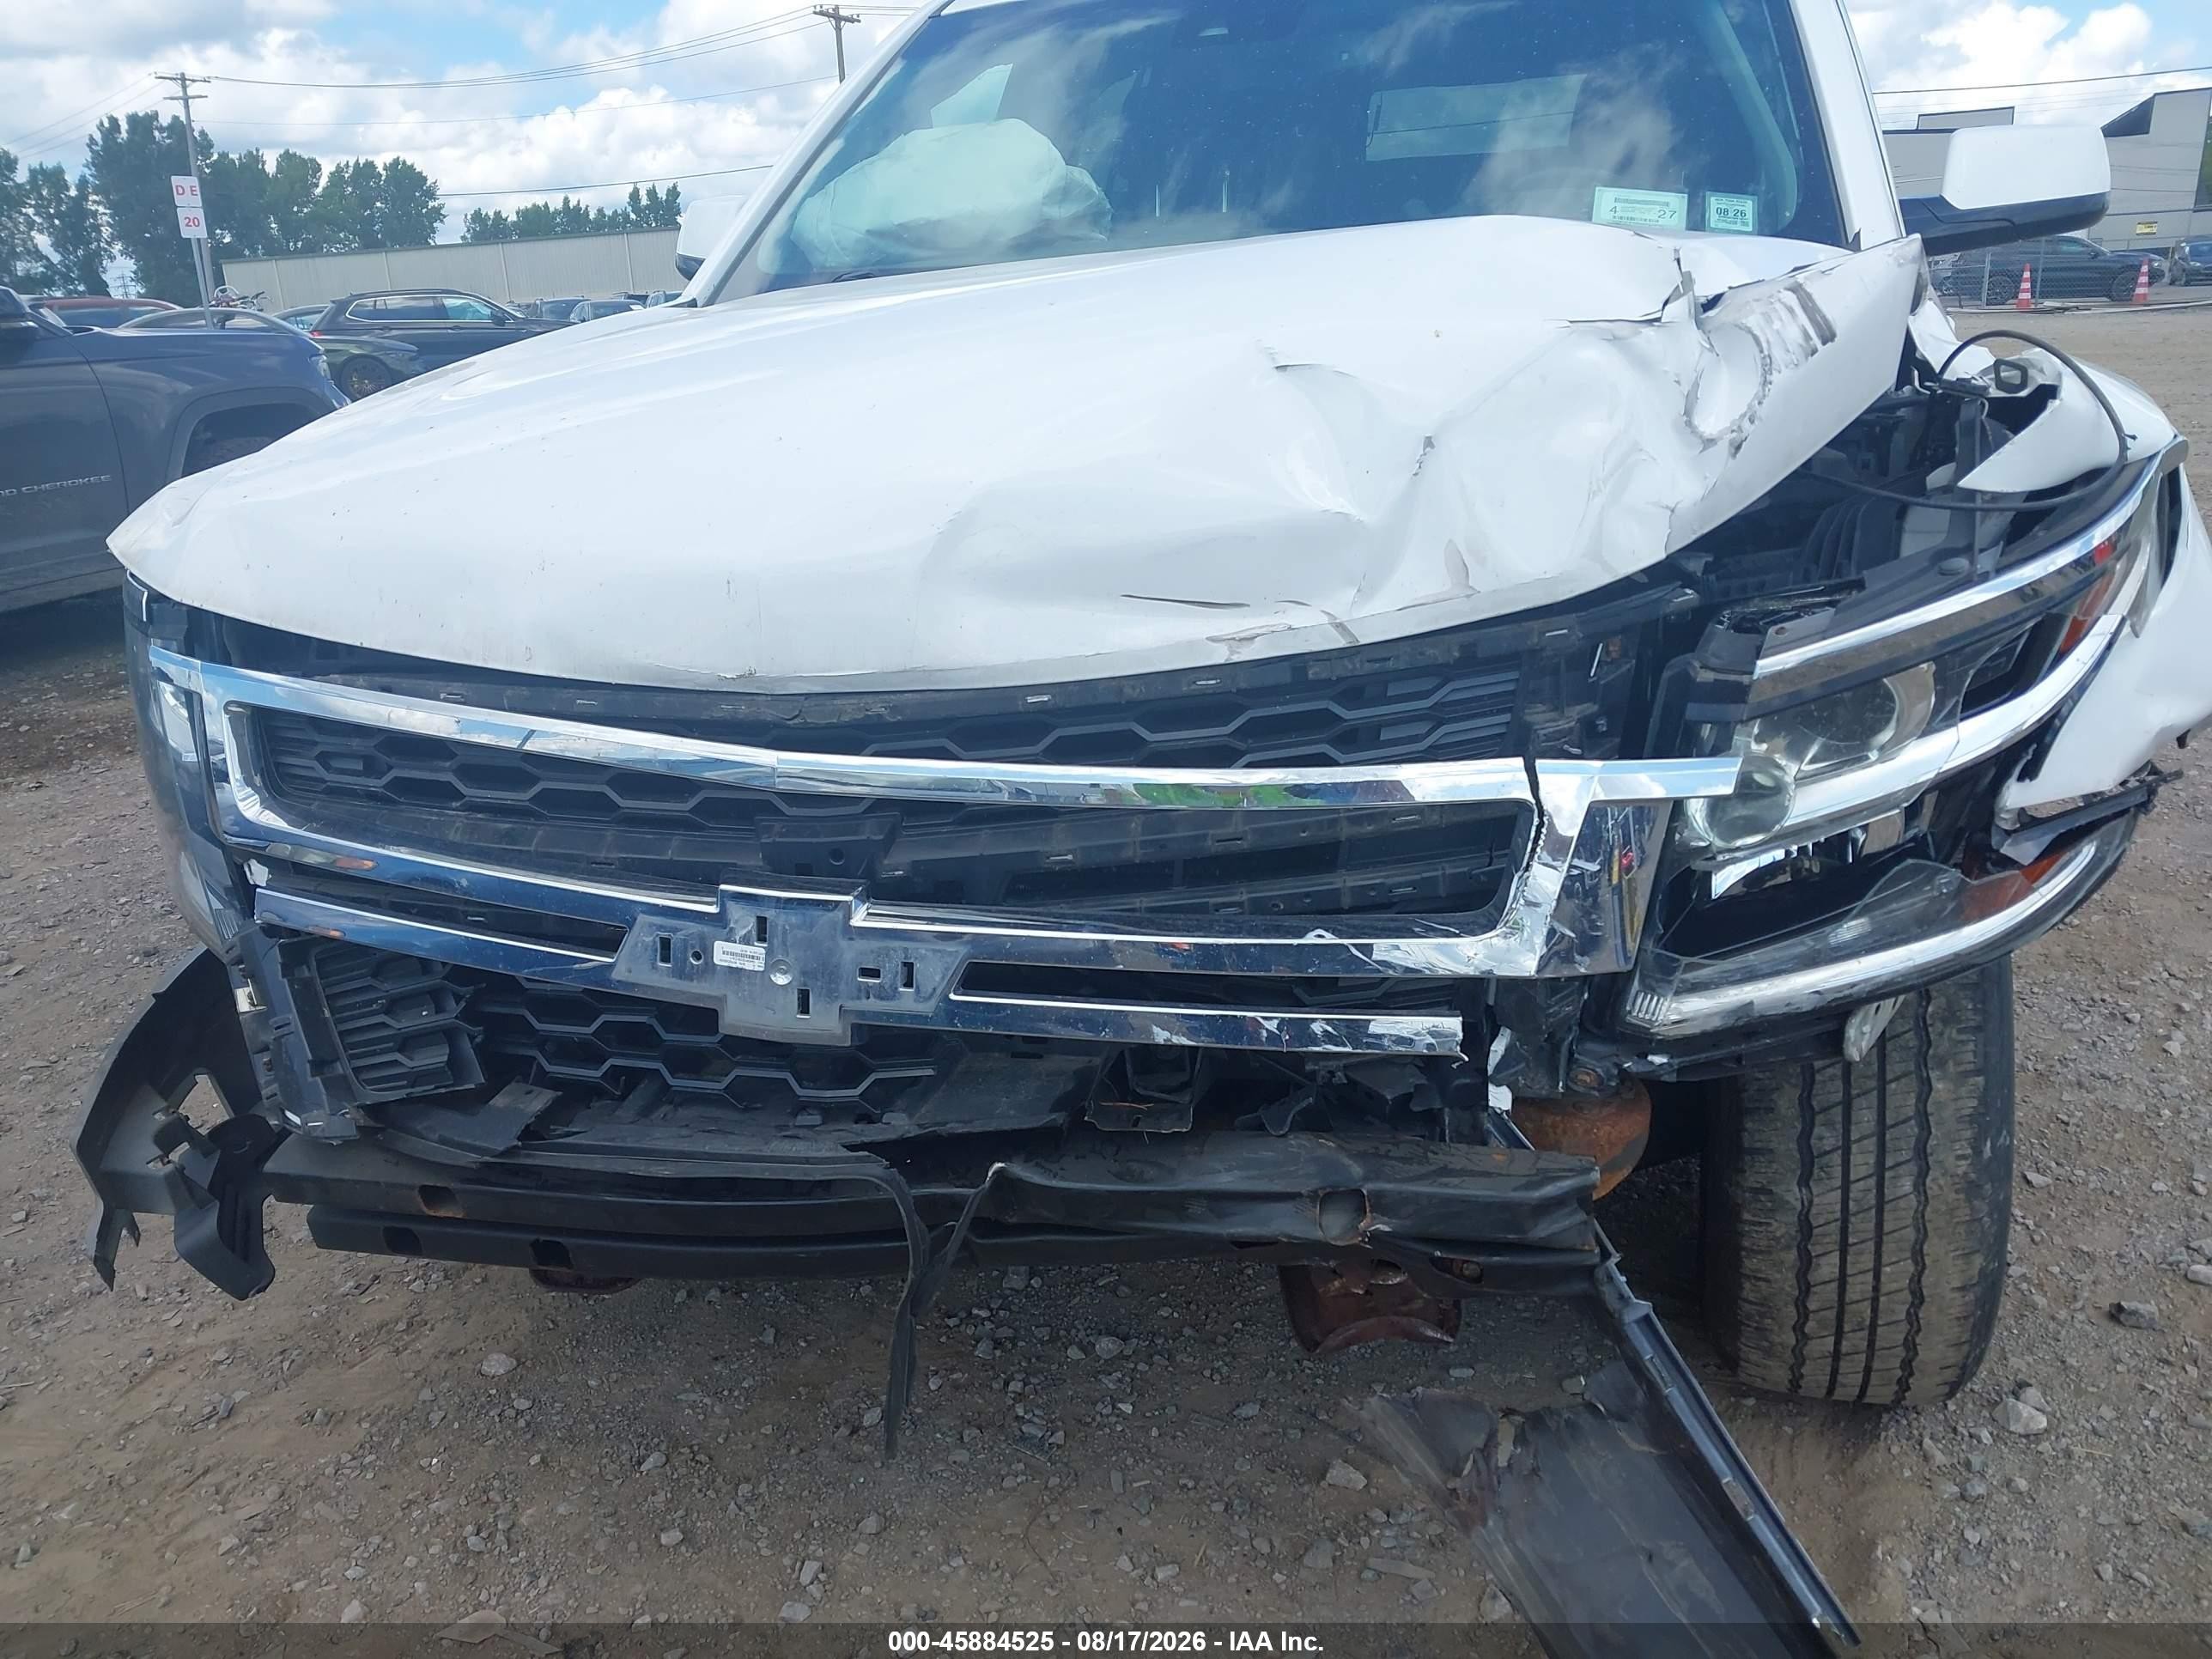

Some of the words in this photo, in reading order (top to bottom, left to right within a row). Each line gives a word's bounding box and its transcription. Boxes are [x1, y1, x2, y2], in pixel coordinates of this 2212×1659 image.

[175, 185, 185, 196] D
[189, 185, 198, 197] E
[1608, 205, 1618, 215] 4
[1657, 209, 1677, 219] 27
[1716, 206, 1729, 216] 08
[1733, 208, 1747, 218] 26
[184, 216, 200, 228] 20
[21, 475, 111, 494] CHEROKEE
